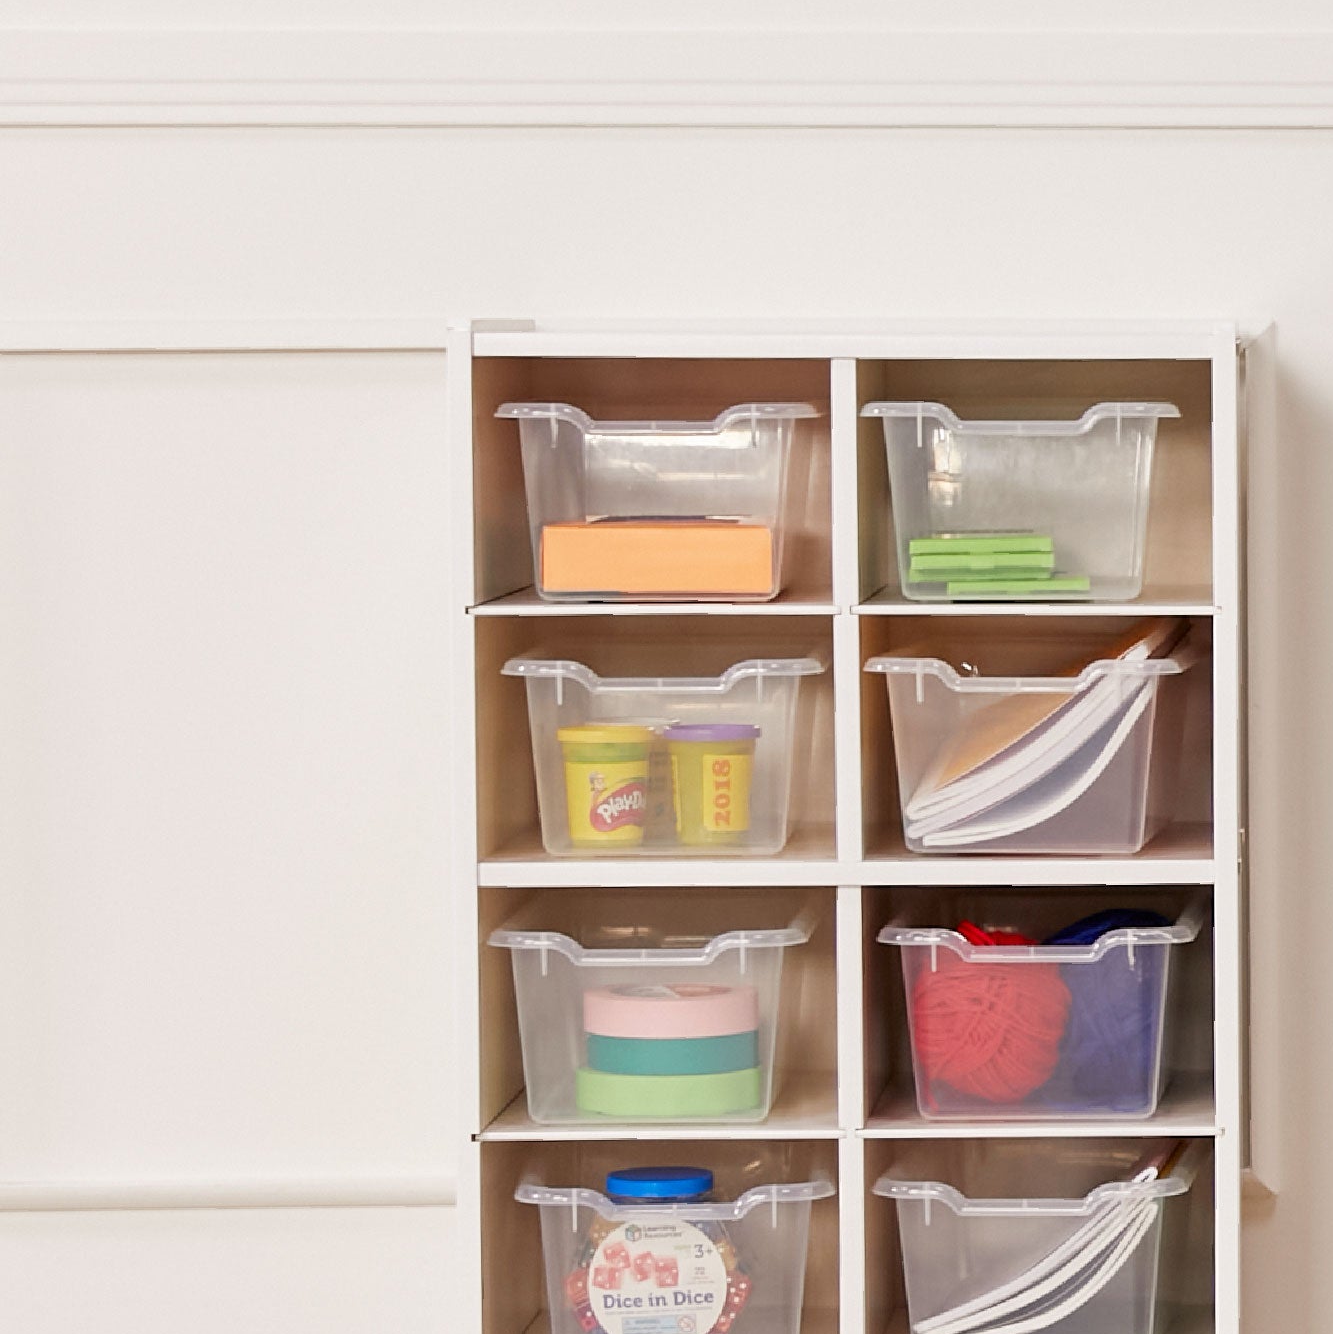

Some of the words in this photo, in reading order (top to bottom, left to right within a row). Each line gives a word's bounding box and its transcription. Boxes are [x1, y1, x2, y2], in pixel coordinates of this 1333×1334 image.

[713, 759, 732, 827] 2018
[603, 1294, 644, 1309] Dice
[648, 1294, 669, 1307] in
[673, 1291, 715, 1306] Dice
